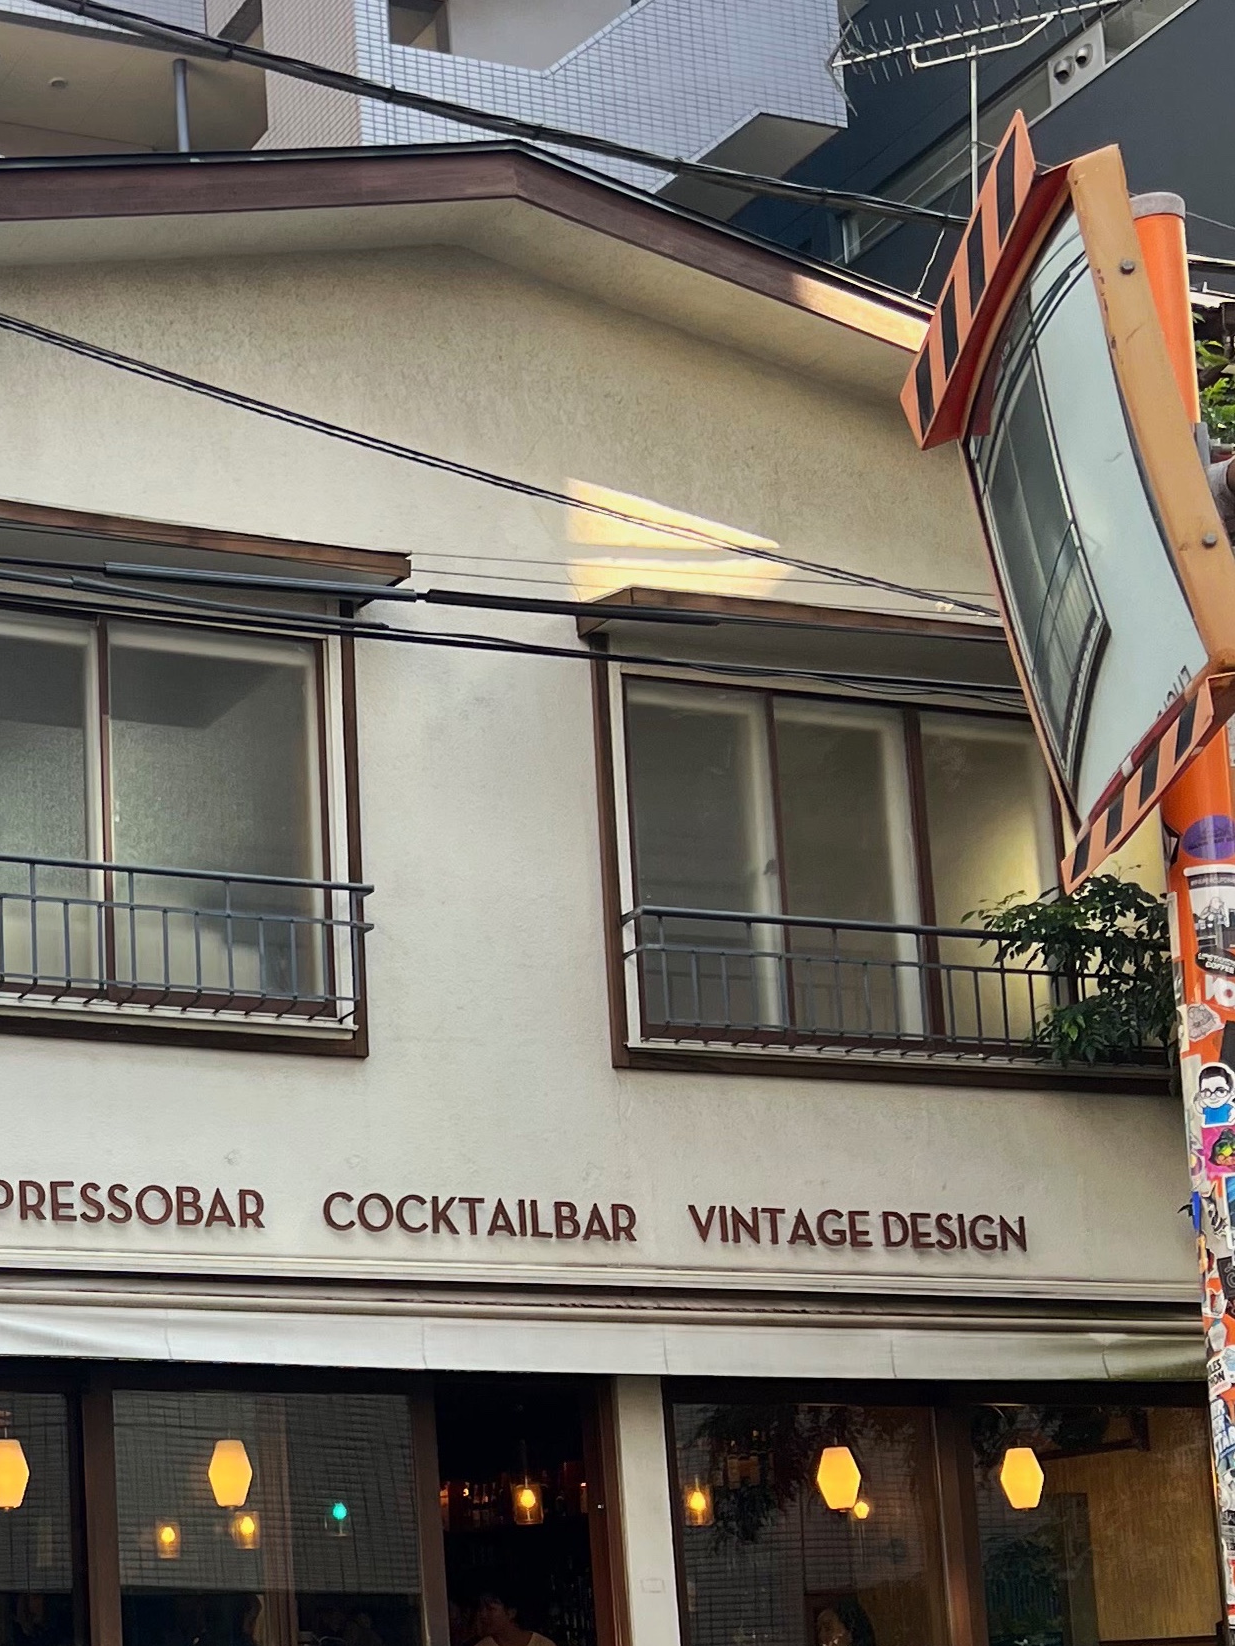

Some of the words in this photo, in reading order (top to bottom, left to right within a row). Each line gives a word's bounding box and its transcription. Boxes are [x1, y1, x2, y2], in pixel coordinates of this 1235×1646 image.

[322, 1191, 637, 1242] COCKTAILBAR
[687, 1204, 873, 1248] VINTAGE
[880, 1210, 1027, 1254] DESIGN
